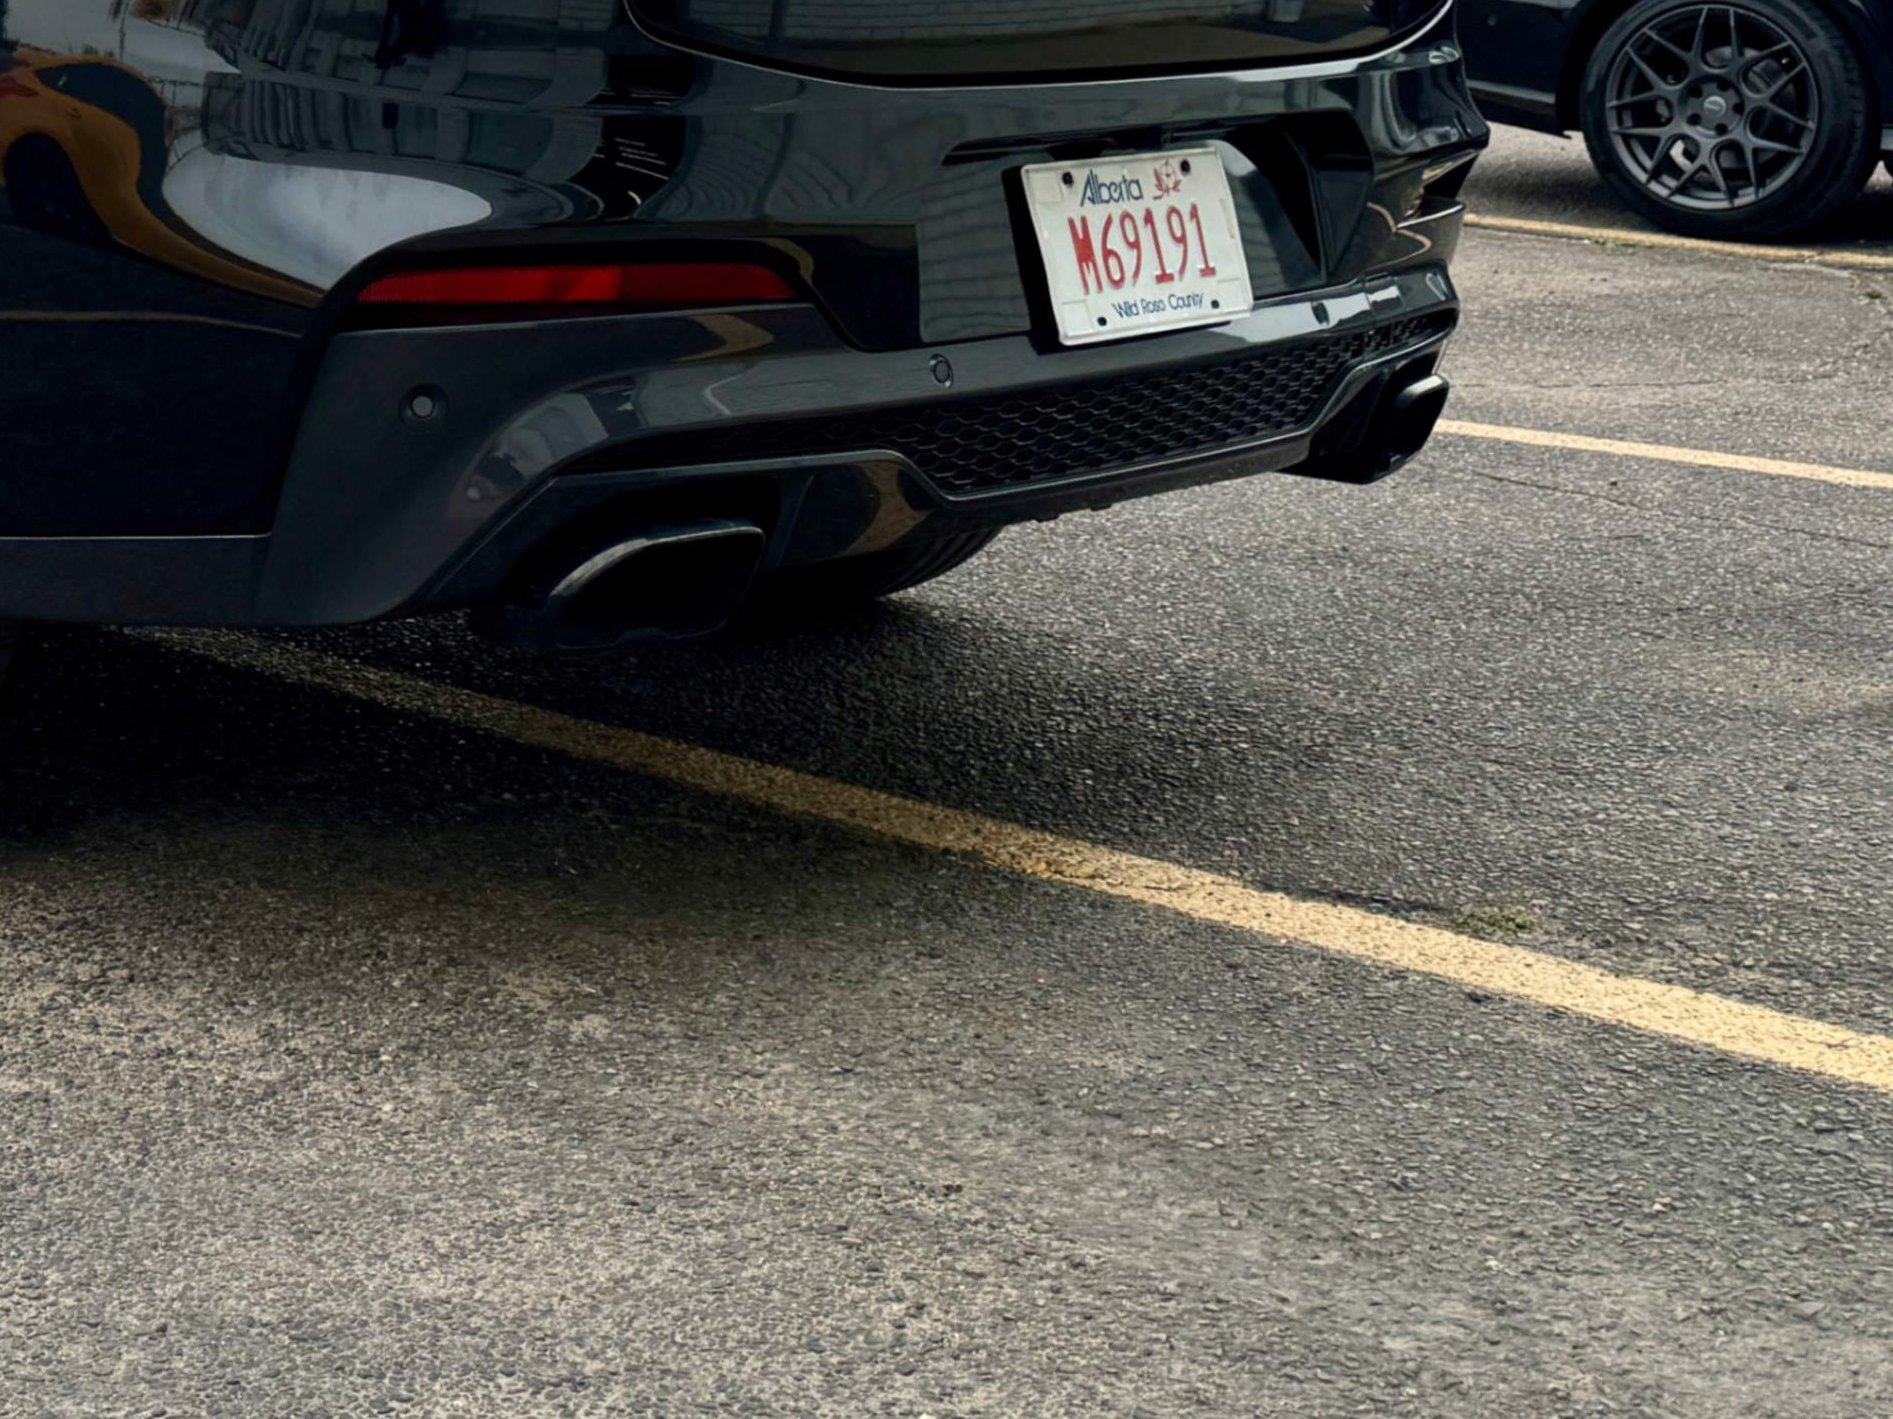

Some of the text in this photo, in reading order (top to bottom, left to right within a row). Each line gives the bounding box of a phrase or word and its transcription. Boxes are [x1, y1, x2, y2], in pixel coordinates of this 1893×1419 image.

[1079, 168, 1144, 207] Alberta
[1067, 202, 1217, 296] M69191
[1111, 300, 1140, 318] Wild
